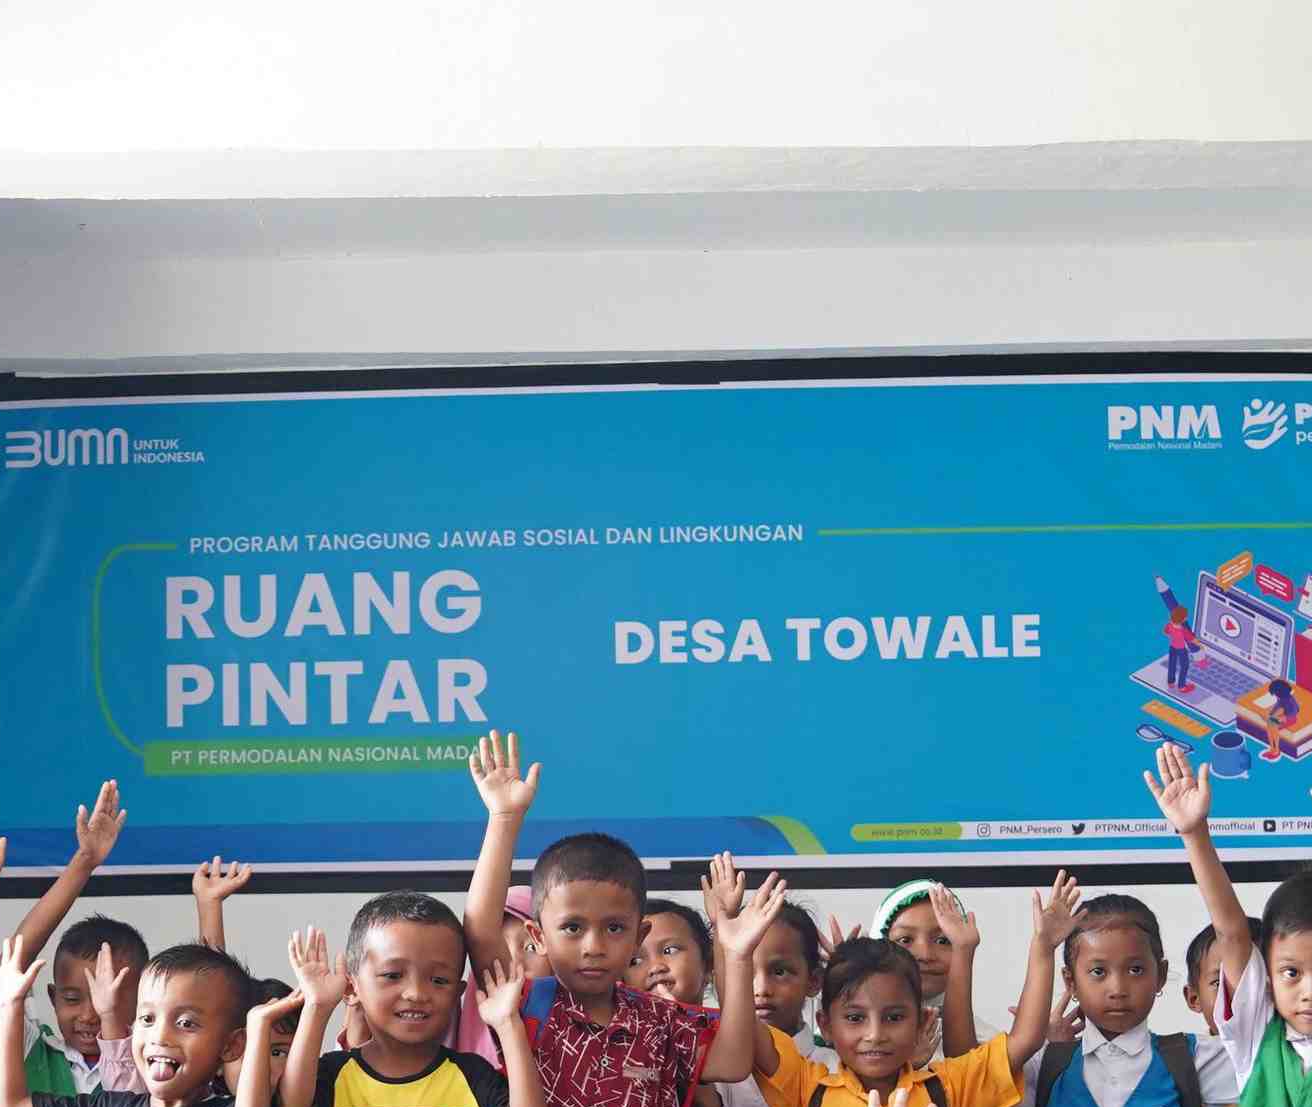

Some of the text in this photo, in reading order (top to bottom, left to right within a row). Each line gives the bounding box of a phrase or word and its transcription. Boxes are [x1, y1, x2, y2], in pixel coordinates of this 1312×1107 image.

[1107, 404, 1222, 440] PNM
[5, 427, 129, 469] BUMN
[133, 438, 179, 450] UNTUK
[133, 451, 206, 465] INDONESIA
[189, 524, 804, 555] PROGRAM TANGGUNG JAWAB SOSIAL DAN LINGKUNGAN
[165, 570, 483, 640] RUANG
[614, 614, 1042, 665] DESA TOWALE
[166, 658, 489, 728] PINTAR
[172, 751, 190, 765] PT
[198, 749, 323, 764] PERMODALAN
[329, 746, 421, 762] NASIONAL
[1209, 820, 1256, 832] nmofficial
